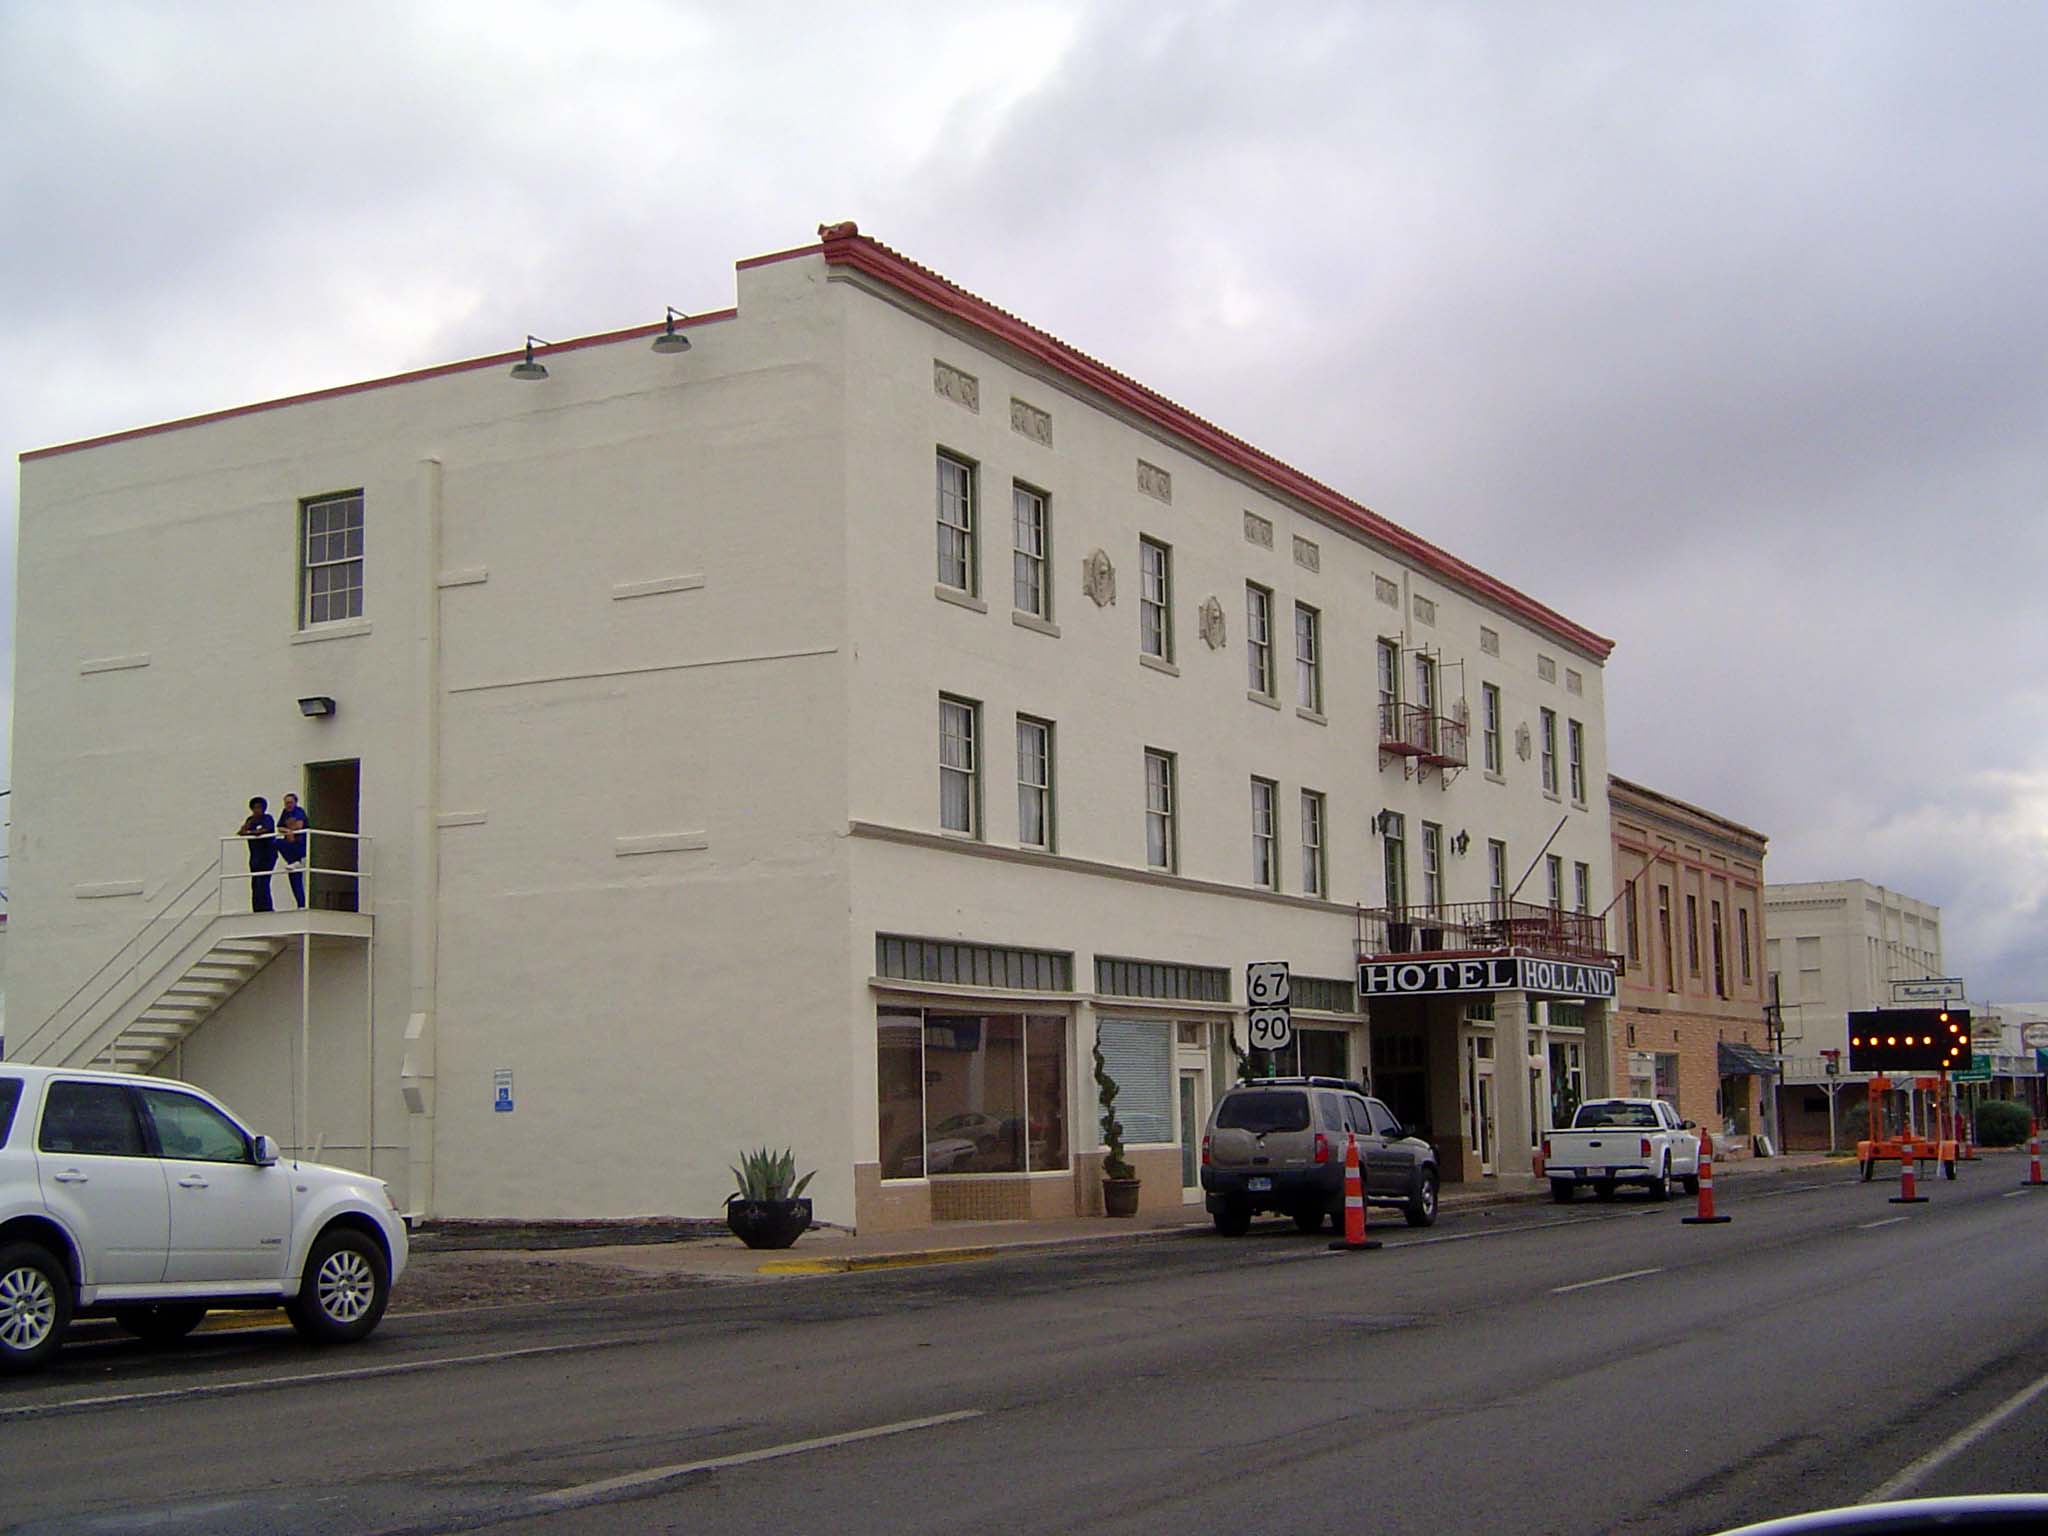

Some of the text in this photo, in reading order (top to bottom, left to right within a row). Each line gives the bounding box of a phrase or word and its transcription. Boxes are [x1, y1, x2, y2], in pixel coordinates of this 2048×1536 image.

[1253, 973, 1285, 997] 67
[1366, 961, 1612, 994] HOTEL HOLLAND
[1255, 1017, 1286, 1040] 90
